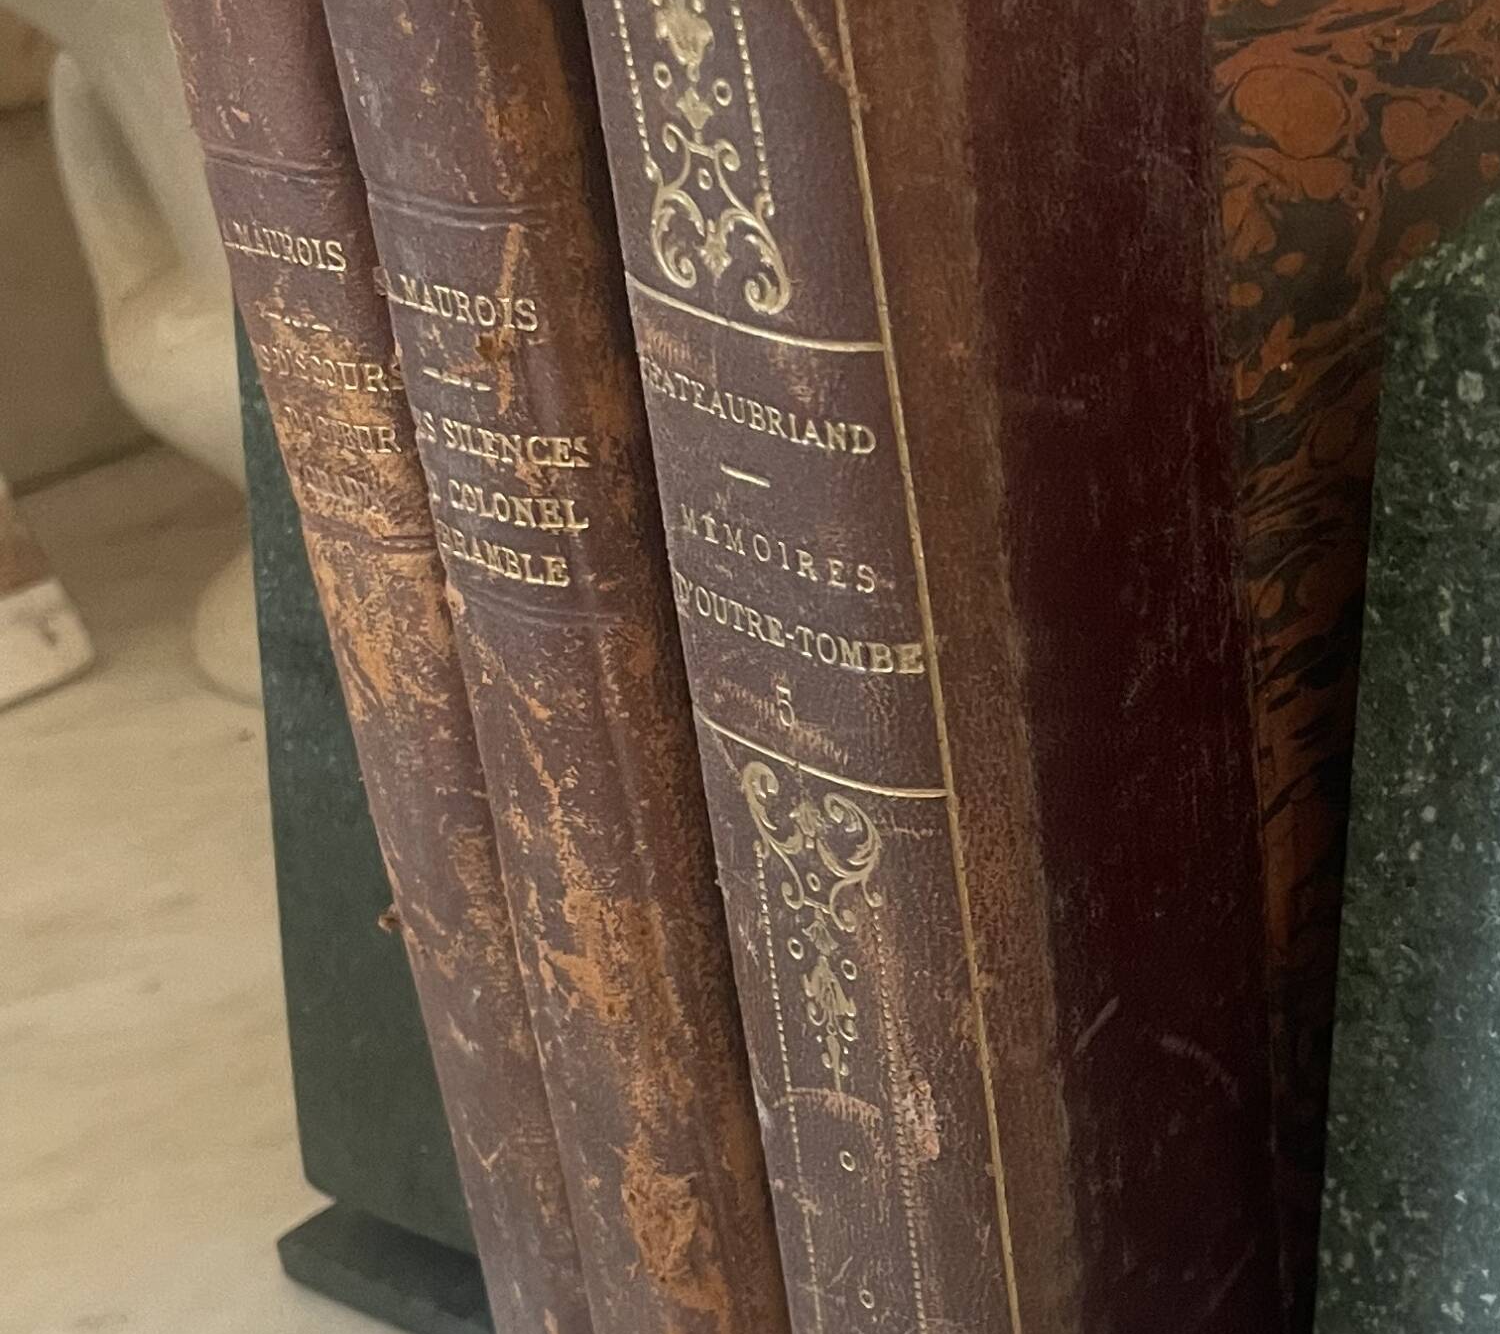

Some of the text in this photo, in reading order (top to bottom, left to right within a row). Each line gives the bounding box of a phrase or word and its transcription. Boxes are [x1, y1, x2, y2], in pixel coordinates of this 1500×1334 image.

[232, 220, 347, 272] MAUROIS
[398, 273, 538, 332] MAUROIS
[441, 417, 591, 468] SILENCES
[448, 478, 590, 531] COLONEL
[435, 518, 571, 587] BRAMBLE
[775, 684, 796, 727] 5
